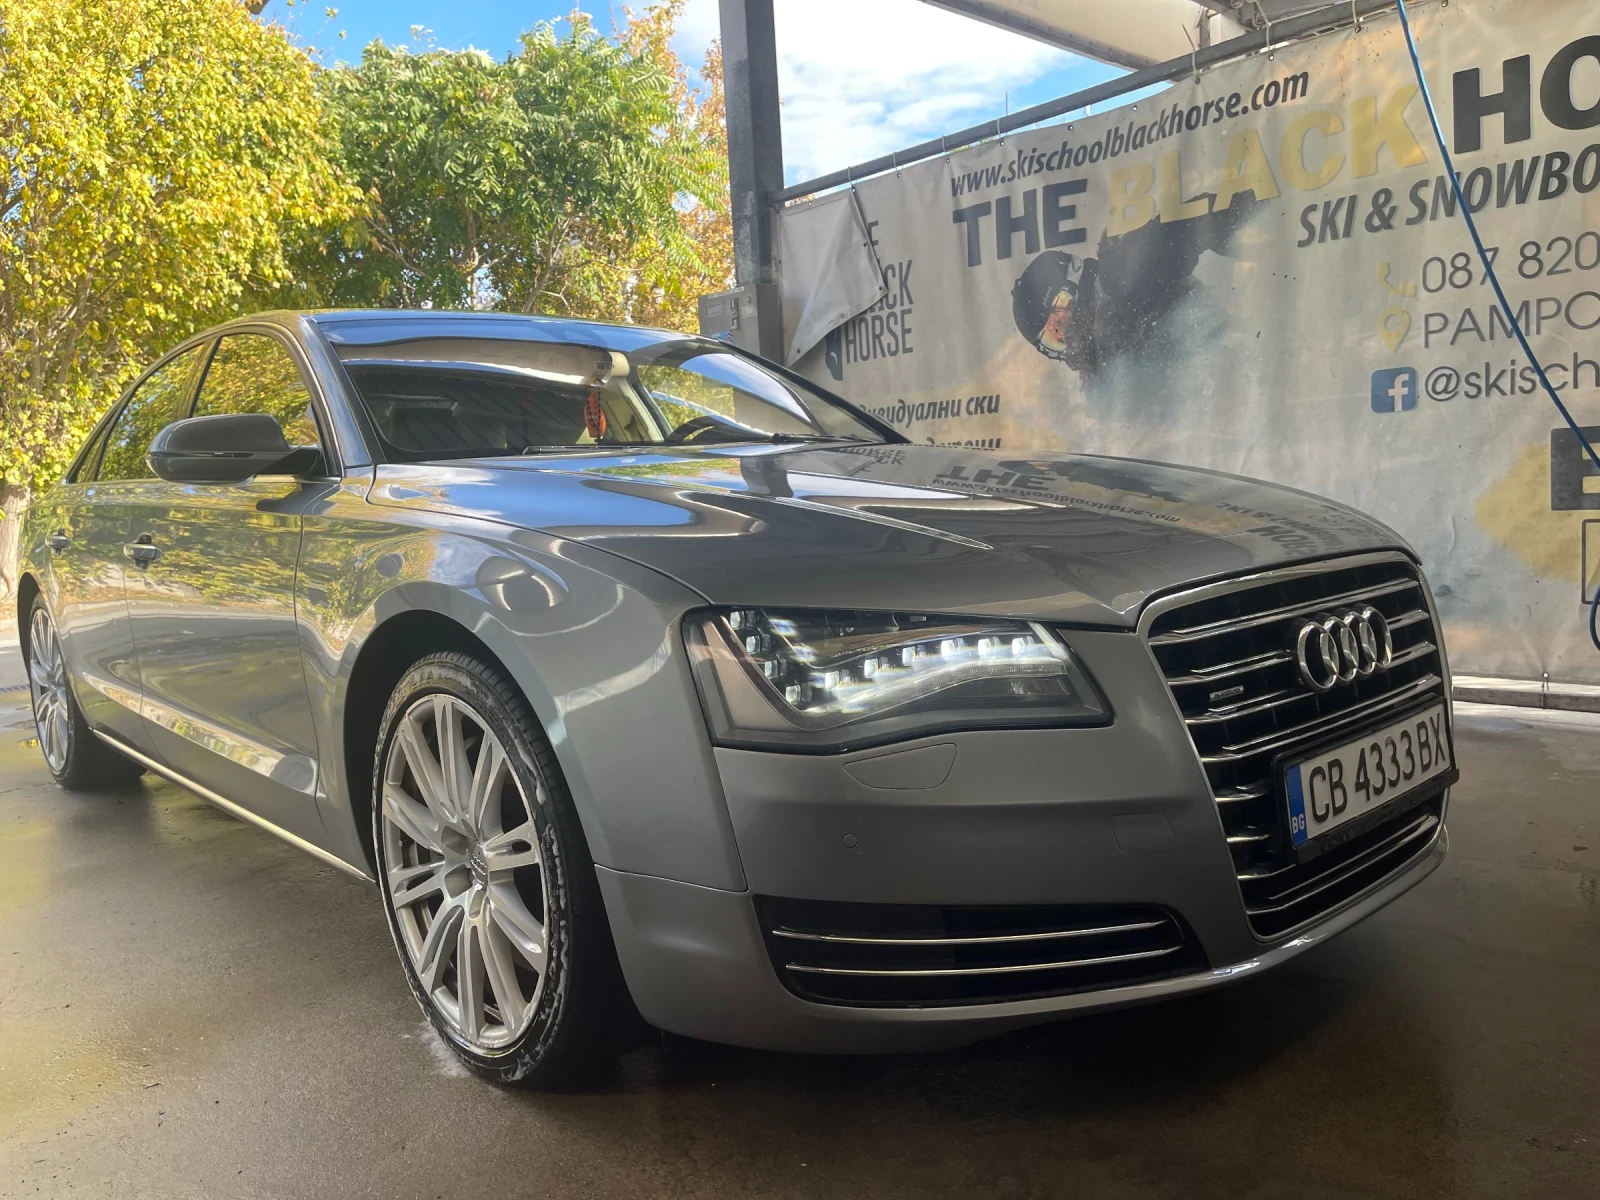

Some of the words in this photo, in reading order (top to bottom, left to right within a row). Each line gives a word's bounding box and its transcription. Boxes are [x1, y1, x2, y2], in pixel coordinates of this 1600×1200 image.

[951, 71, 1309, 197] www.skischoolblackhorse.com
[952, 179, 1088, 267] THE
[1107, 84, 1428, 238] BLACK
[1453, 35, 1600, 154] HO
[1297, 195, 1357, 247] SKI
[1364, 188, 1397, 233] &
[1405, 143, 1600, 225] SNOWBO
[1422, 247, 1499, 293] 087
[1518, 231, 1600, 279] 820
[845, 308, 914, 363] HORSE
[1424, 291, 1600, 349] PAMPO
[965, 395, 1000, 415] ски
[1425, 352, 1600, 402] @skisch
[1309, 758, 1348, 824] CB
[1354, 729, 1416, 802] 4333
[1416, 712, 1447, 773] BX
[1292, 813, 1305, 836] BG
